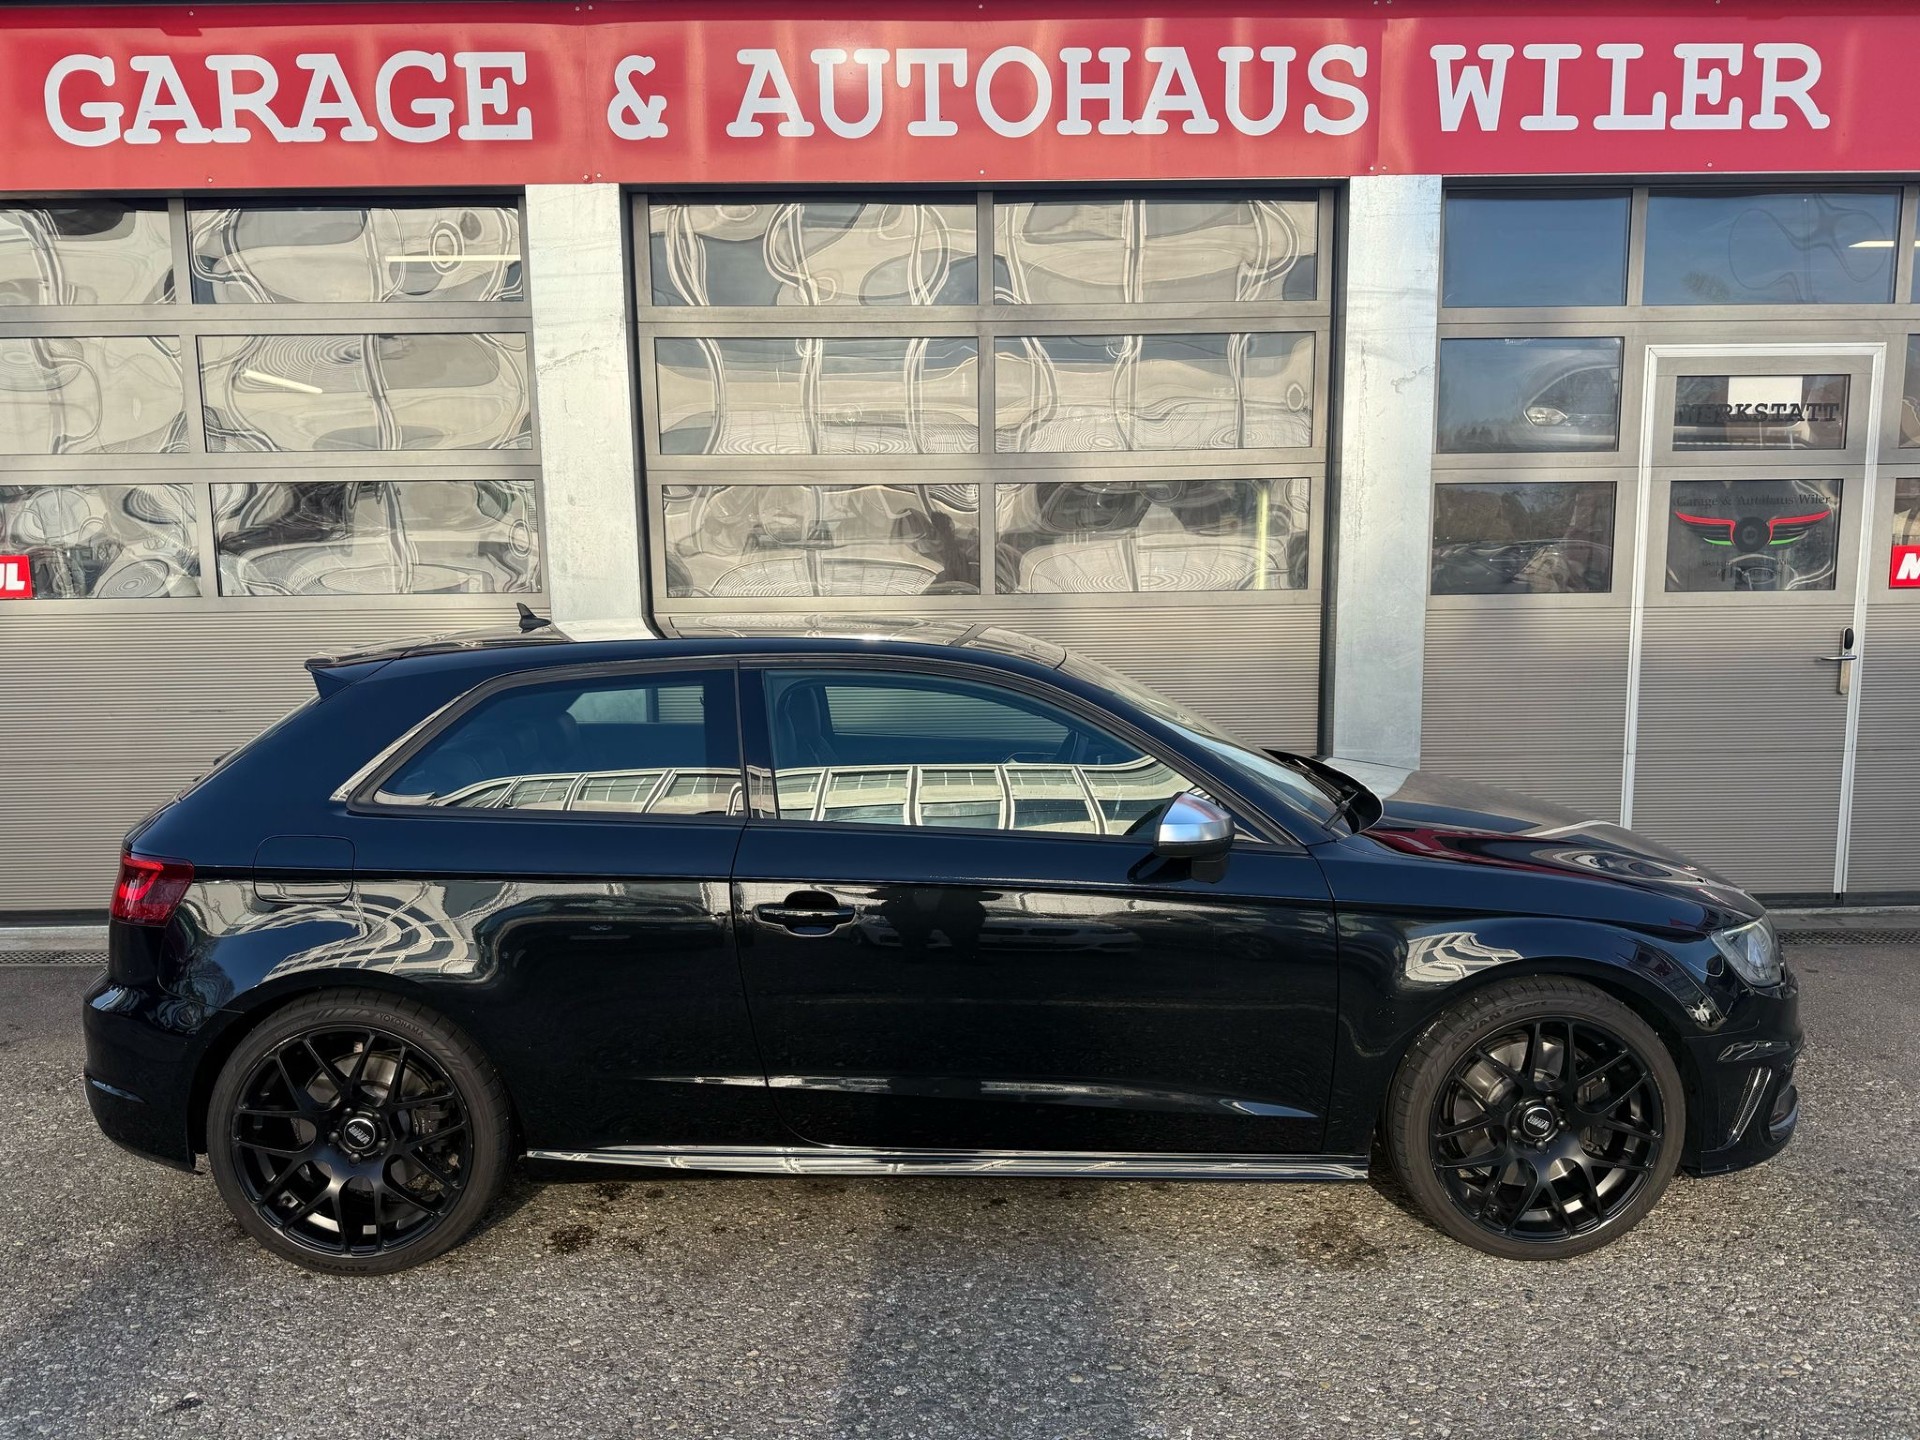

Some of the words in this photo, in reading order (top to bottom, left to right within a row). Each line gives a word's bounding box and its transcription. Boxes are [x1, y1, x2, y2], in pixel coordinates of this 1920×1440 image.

[44, 50, 532, 147] GARAGE
[607, 55, 668, 139] &
[726, 45, 1369, 138] AUTOHAUS
[1429, 43, 1830, 132] WILER
[1677, 402, 1840, 424] WERKSTATT
[1799, 493, 1831, 505] Wiler
[378, 1012, 424, 1039] YOKOHAMA
[1451, 1011, 1502, 1050] ADVAN
